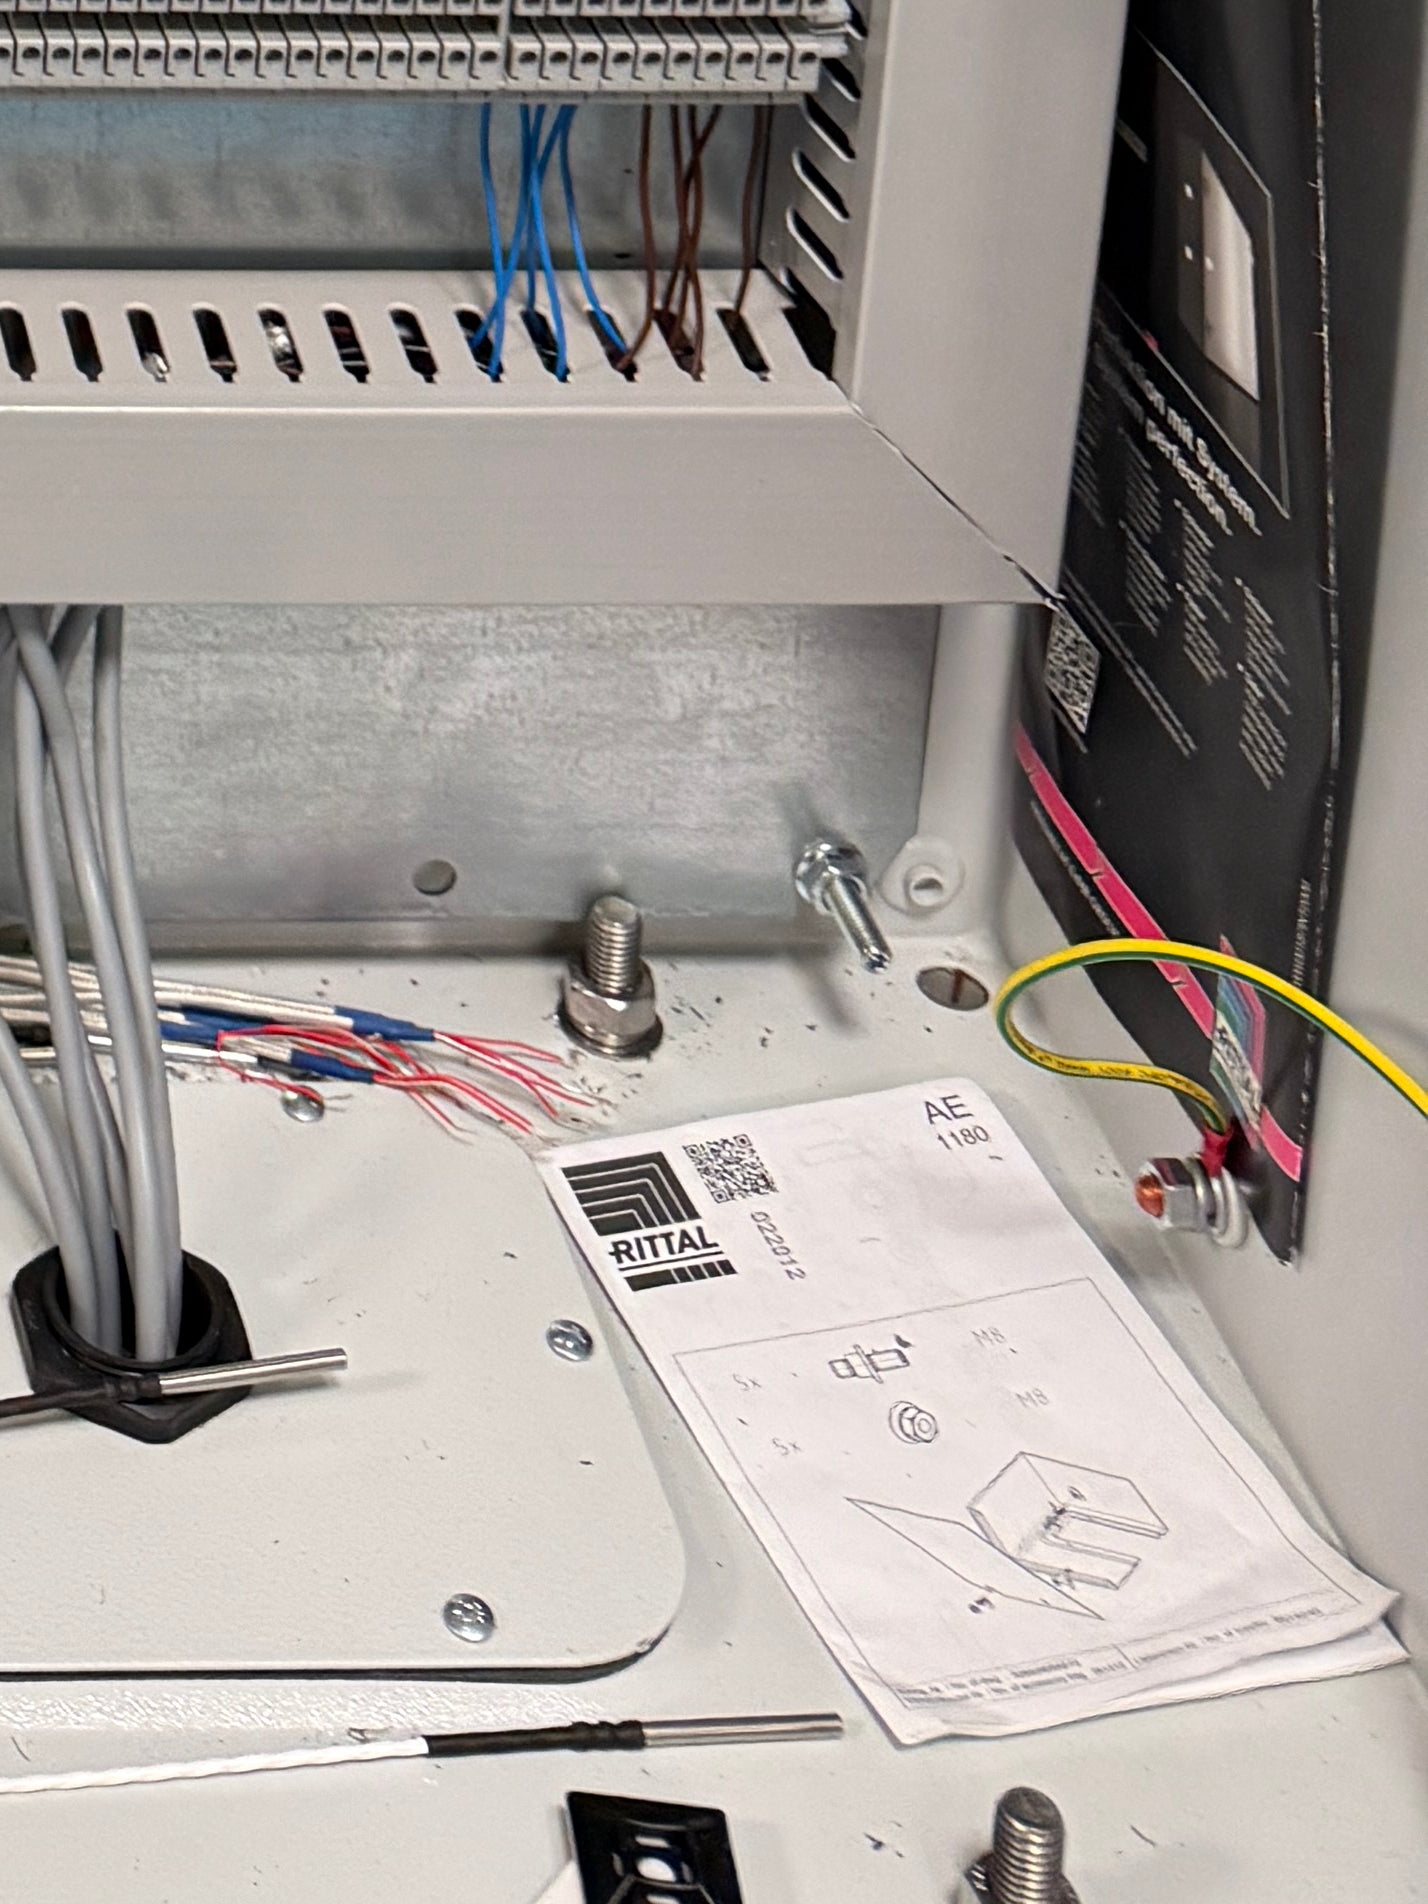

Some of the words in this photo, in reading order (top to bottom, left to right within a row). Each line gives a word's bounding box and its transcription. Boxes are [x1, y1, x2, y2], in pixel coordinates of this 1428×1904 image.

[922, 1093, 975, 1127] AE
[936, 1123, 992, 1154] 1180
[610, 1223, 720, 1268] RITTAL
[752, 1210, 808, 1283] 022012
[971, 1326, 1007, 1347] M8
[1016, 1388, 1051, 1410] M8
